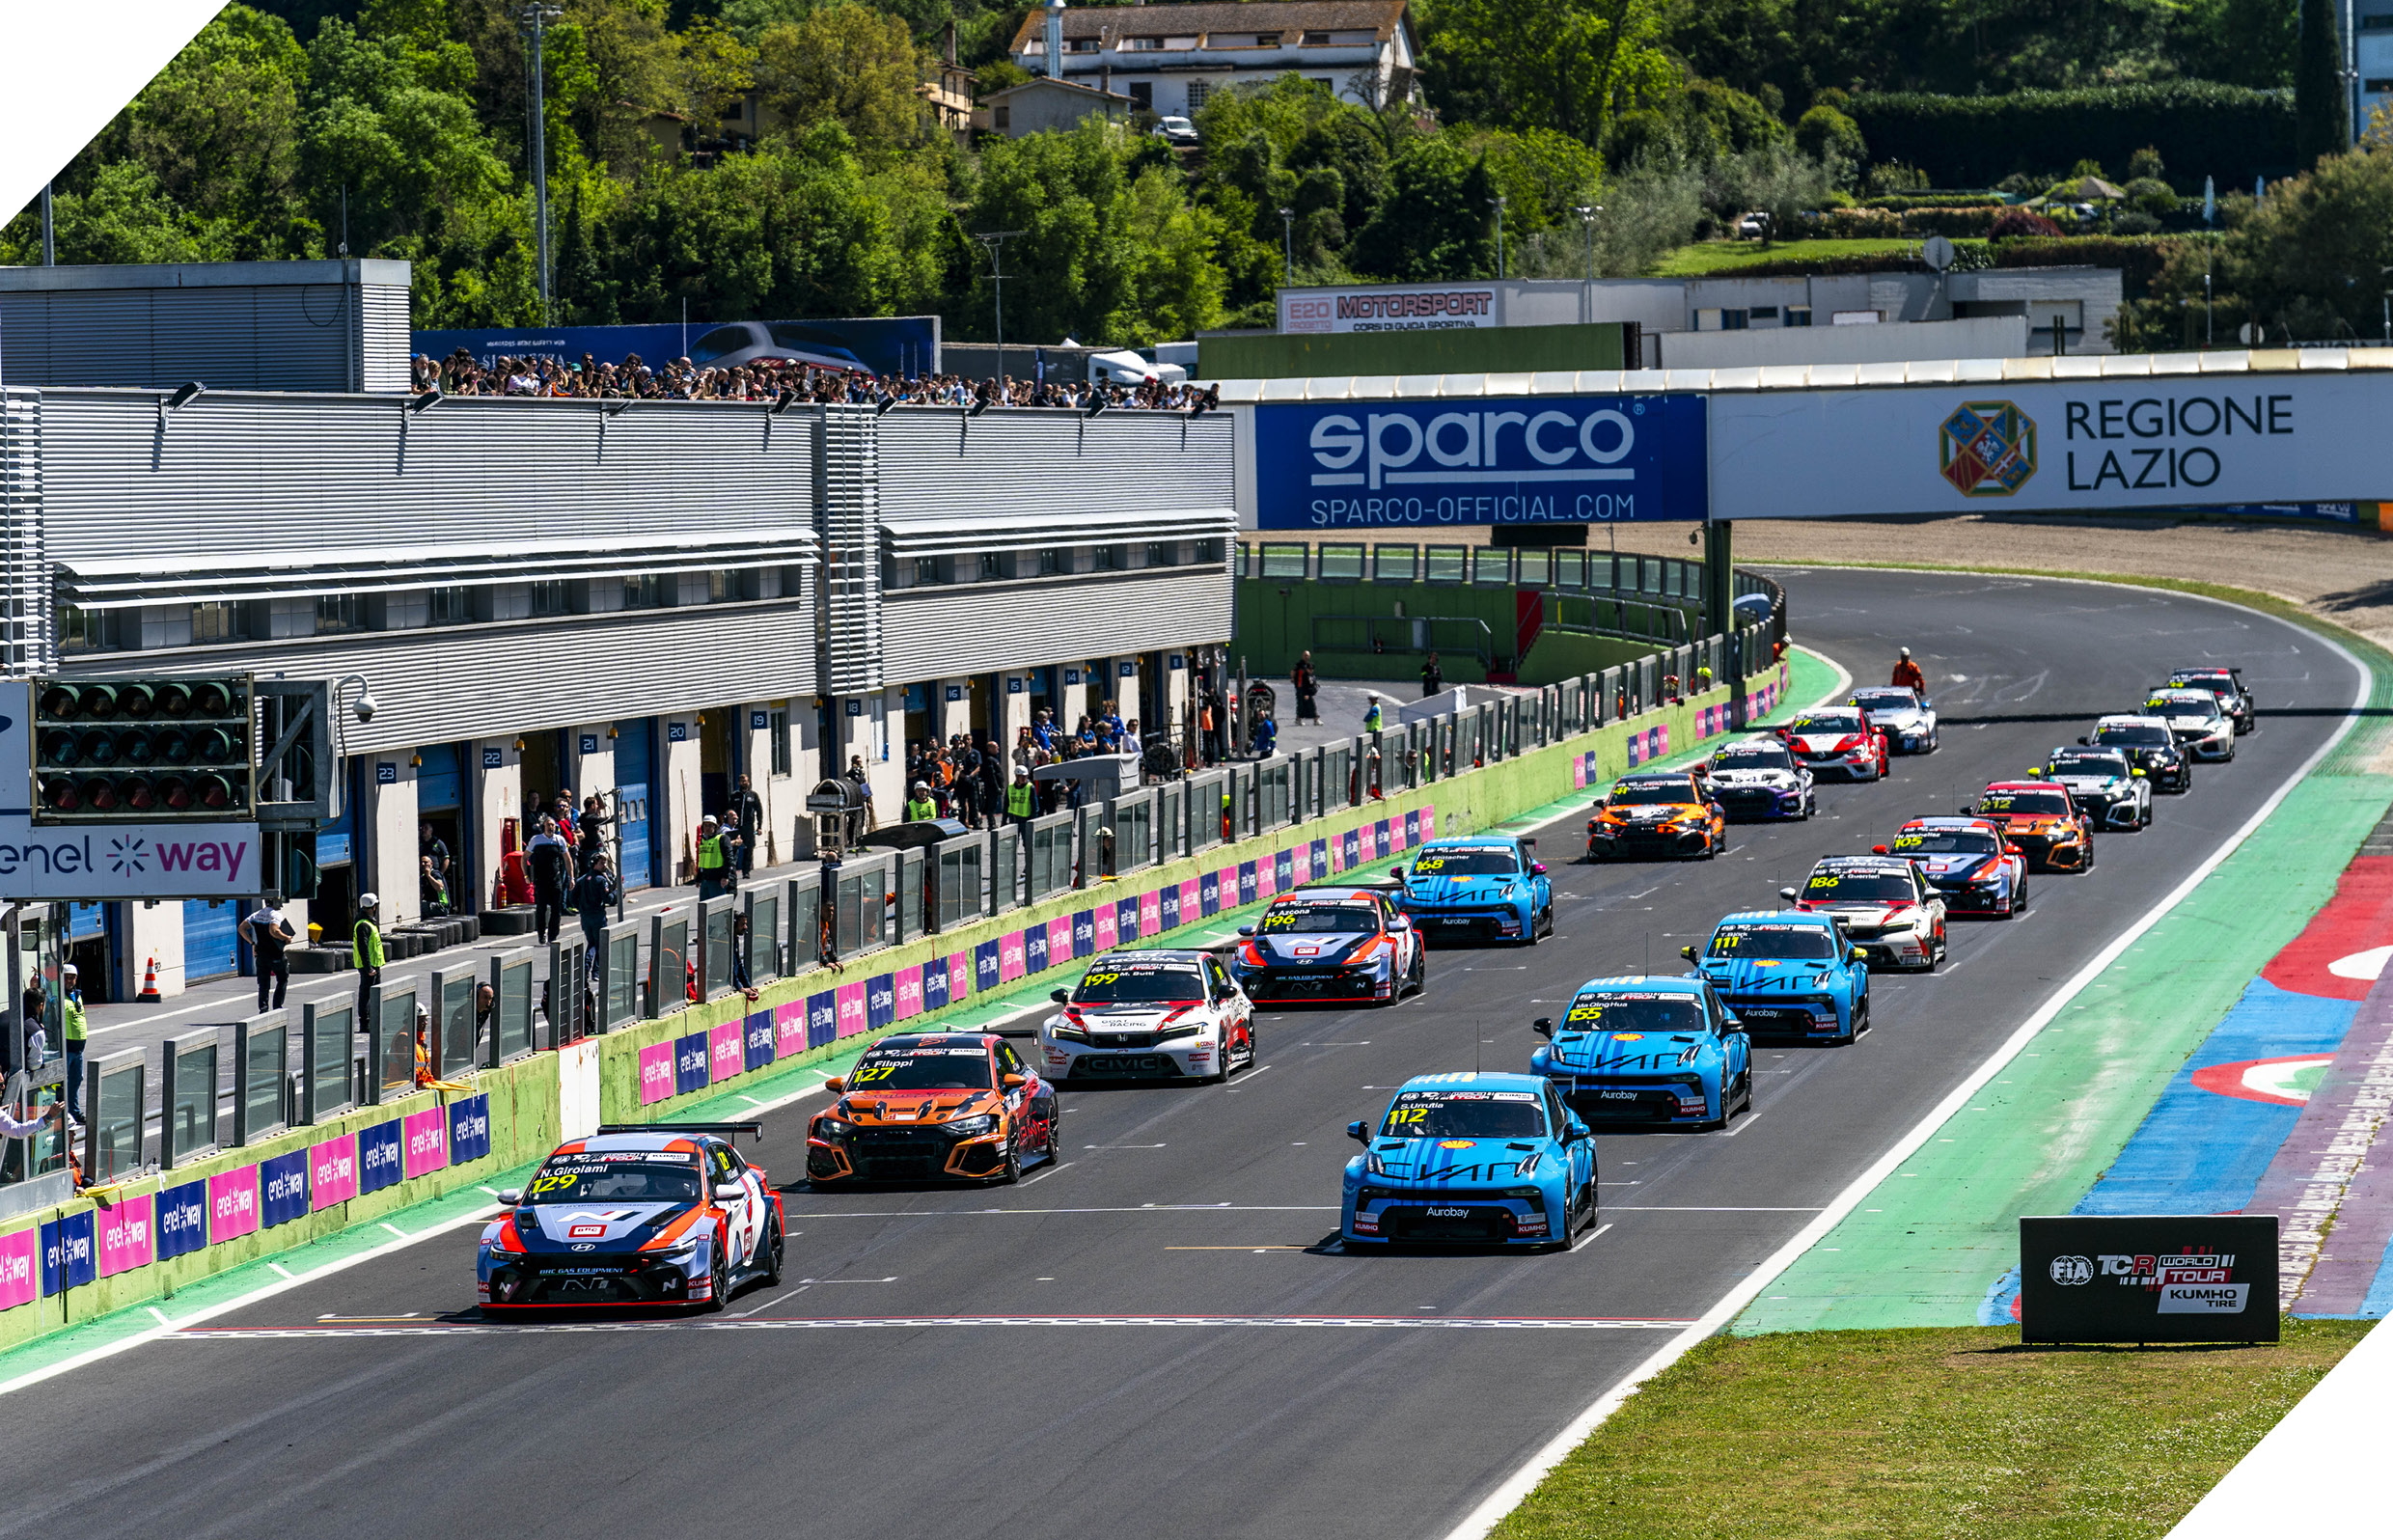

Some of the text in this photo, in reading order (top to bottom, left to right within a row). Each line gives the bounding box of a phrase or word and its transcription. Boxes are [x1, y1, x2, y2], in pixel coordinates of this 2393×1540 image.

[1290, 302, 1329, 319] E20
[1337, 291, 1493, 319] MOTORSPORT
[2066, 395, 2294, 440] REGIONE
[1309, 409, 1635, 489] sparco
[2067, 447, 2221, 491] LAZIO
[1310, 494, 1635, 525] SPARCO-OFFICIAL.COM
[1067, 673, 1076, 682] 14
[1010, 681, 1019, 690] 15
[949, 689, 958, 698] 16
[848, 702, 859, 713] 18
[754, 715, 763, 726] 19
[670, 727, 684, 737] 20
[583, 739, 594, 751] 21
[484, 753, 500, 764] 22
[378, 768, 395, 780] 23
[1980, 799, 2011, 811] 212
[1894, 836, 1923, 848] 105
[0, 835, 247, 882] enel way
[1415, 859, 1444, 871] 168
[1809, 876, 1839, 889] 186
[1264, 914, 1296, 927] 196
[1715, 936, 1740, 949] 111
[1084, 973, 1119, 987] 199
[1568, 1006, 1603, 1022] 155
[1745, 1009, 1778, 1018] Aurobay
[1091, 1059, 1156, 1070] CIVIC
[853, 1067, 895, 1084] 127
[1601, 1090, 1637, 1101] Aurobay
[1389, 1109, 1428, 1125] 112
[456, 1115, 486, 1142] enel way
[411, 1128, 443, 1156] enel way
[366, 1141, 399, 1169] enel way
[317, 1156, 351, 1186] enel way
[539, 1164, 609, 1178] N.Girolami
[268, 1171, 304, 1201] enel way
[532, 1173, 578, 1194] 129
[217, 1188, 253, 1219] enel way
[163, 1202, 202, 1234] enel way
[1426, 1207, 1470, 1219] Aurobay
[1355, 1223, 1379, 1231] KUMHO
[1518, 1224, 1547, 1233] KUMHO
[106, 1220, 147, 1251] enel way
[72, 1236, 90, 1265] way
[2097, 1254, 2157, 1276] TCR
[2161, 1257, 2214, 1266] WORLD
[13, 1254, 30, 1284] way
[2169, 1271, 2226, 1282] TOUR
[2170, 1289, 2237, 1300] KUMHO
